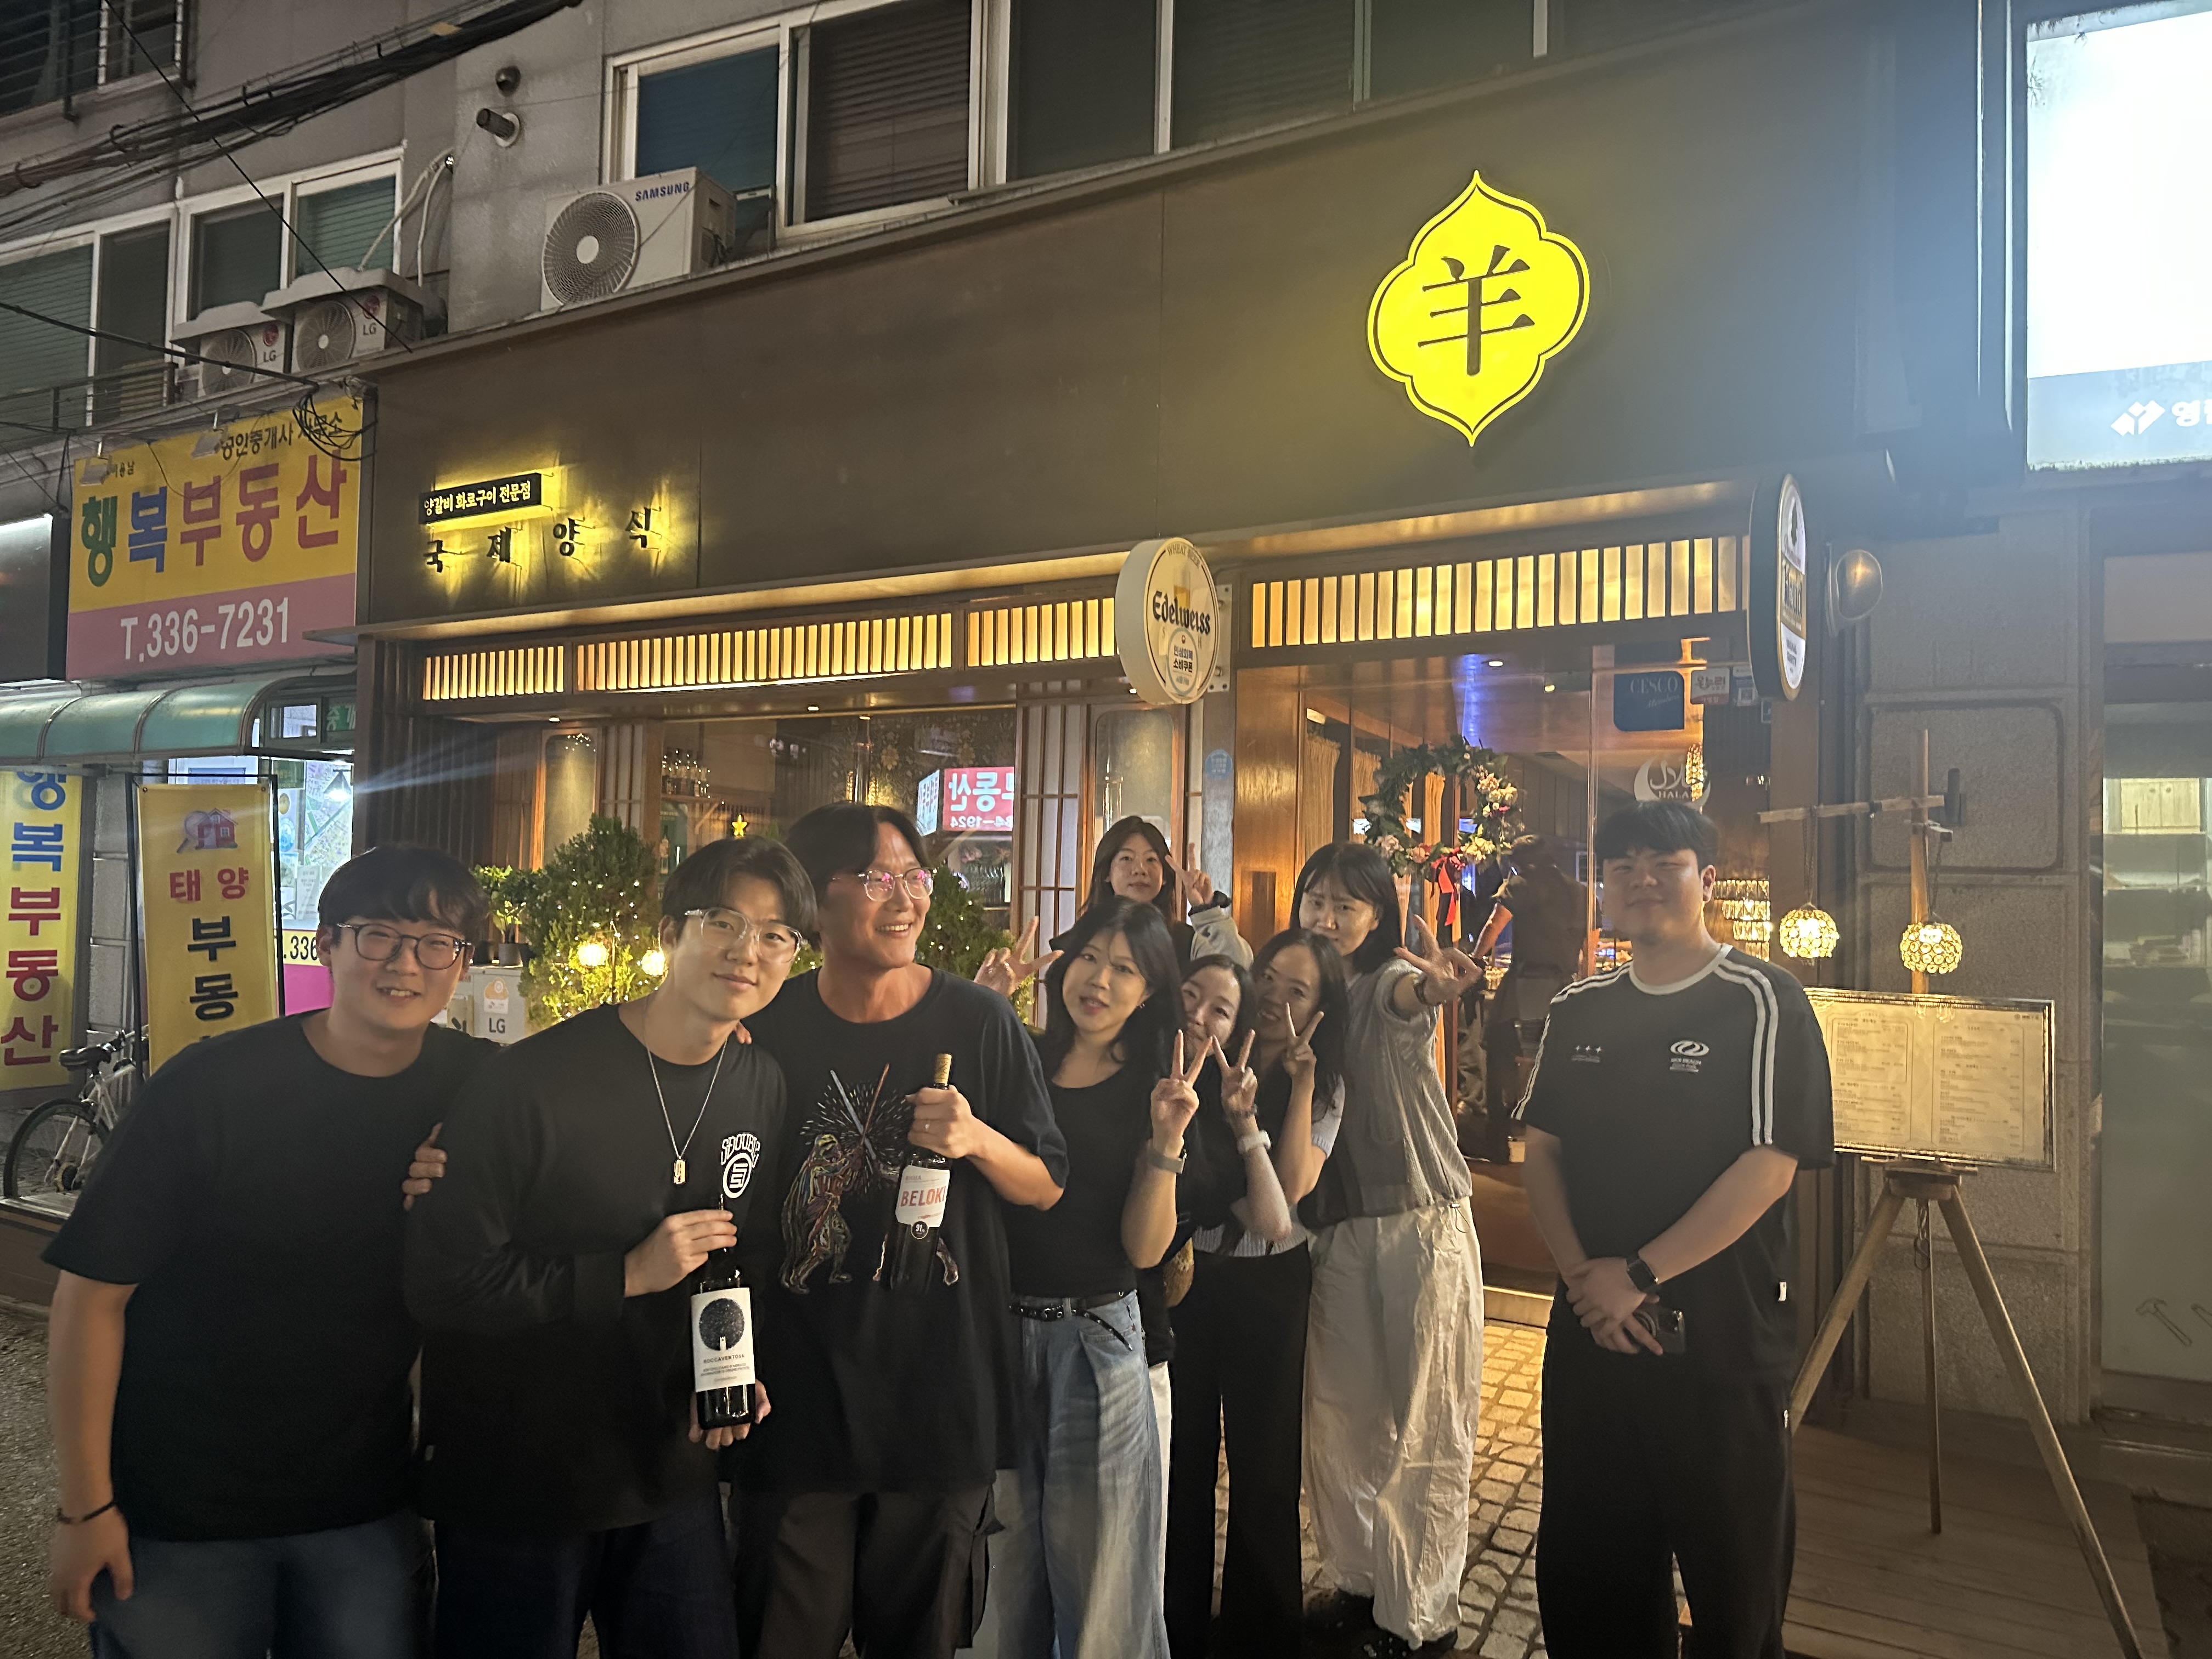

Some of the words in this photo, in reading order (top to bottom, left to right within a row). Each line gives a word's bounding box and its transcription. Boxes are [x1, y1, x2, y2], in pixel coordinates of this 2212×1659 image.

[635, 182, 689, 201] SAMSUNG
[1418, 245, 1535, 377] 羊
[363, 323, 376, 336] LG
[263, 351, 276, 362] LG
[2171, 399, 2212, 427] 영
[221, 423, 294, 460] 공인중개사
[424, 494, 453, 516] 양갈비
[455, 487, 496, 510] 화로구이
[499, 480, 531, 504] 전문점
[81, 450, 347, 587] 행복부동산
[1167, 544, 1186, 556] WHEAT
[1152, 590, 1211, 635] Edelweiss
[121, 597, 289, 663] T.336-7231
[1630, 676, 1679, 693] CESCO
[1658, 791, 1690, 799] HALA
[170, 867, 249, 903] 태양
[187, 916, 239, 1039] 부동
[489, 1018, 506, 1033] LG
[901, 1186, 946, 1206] BELOKI
